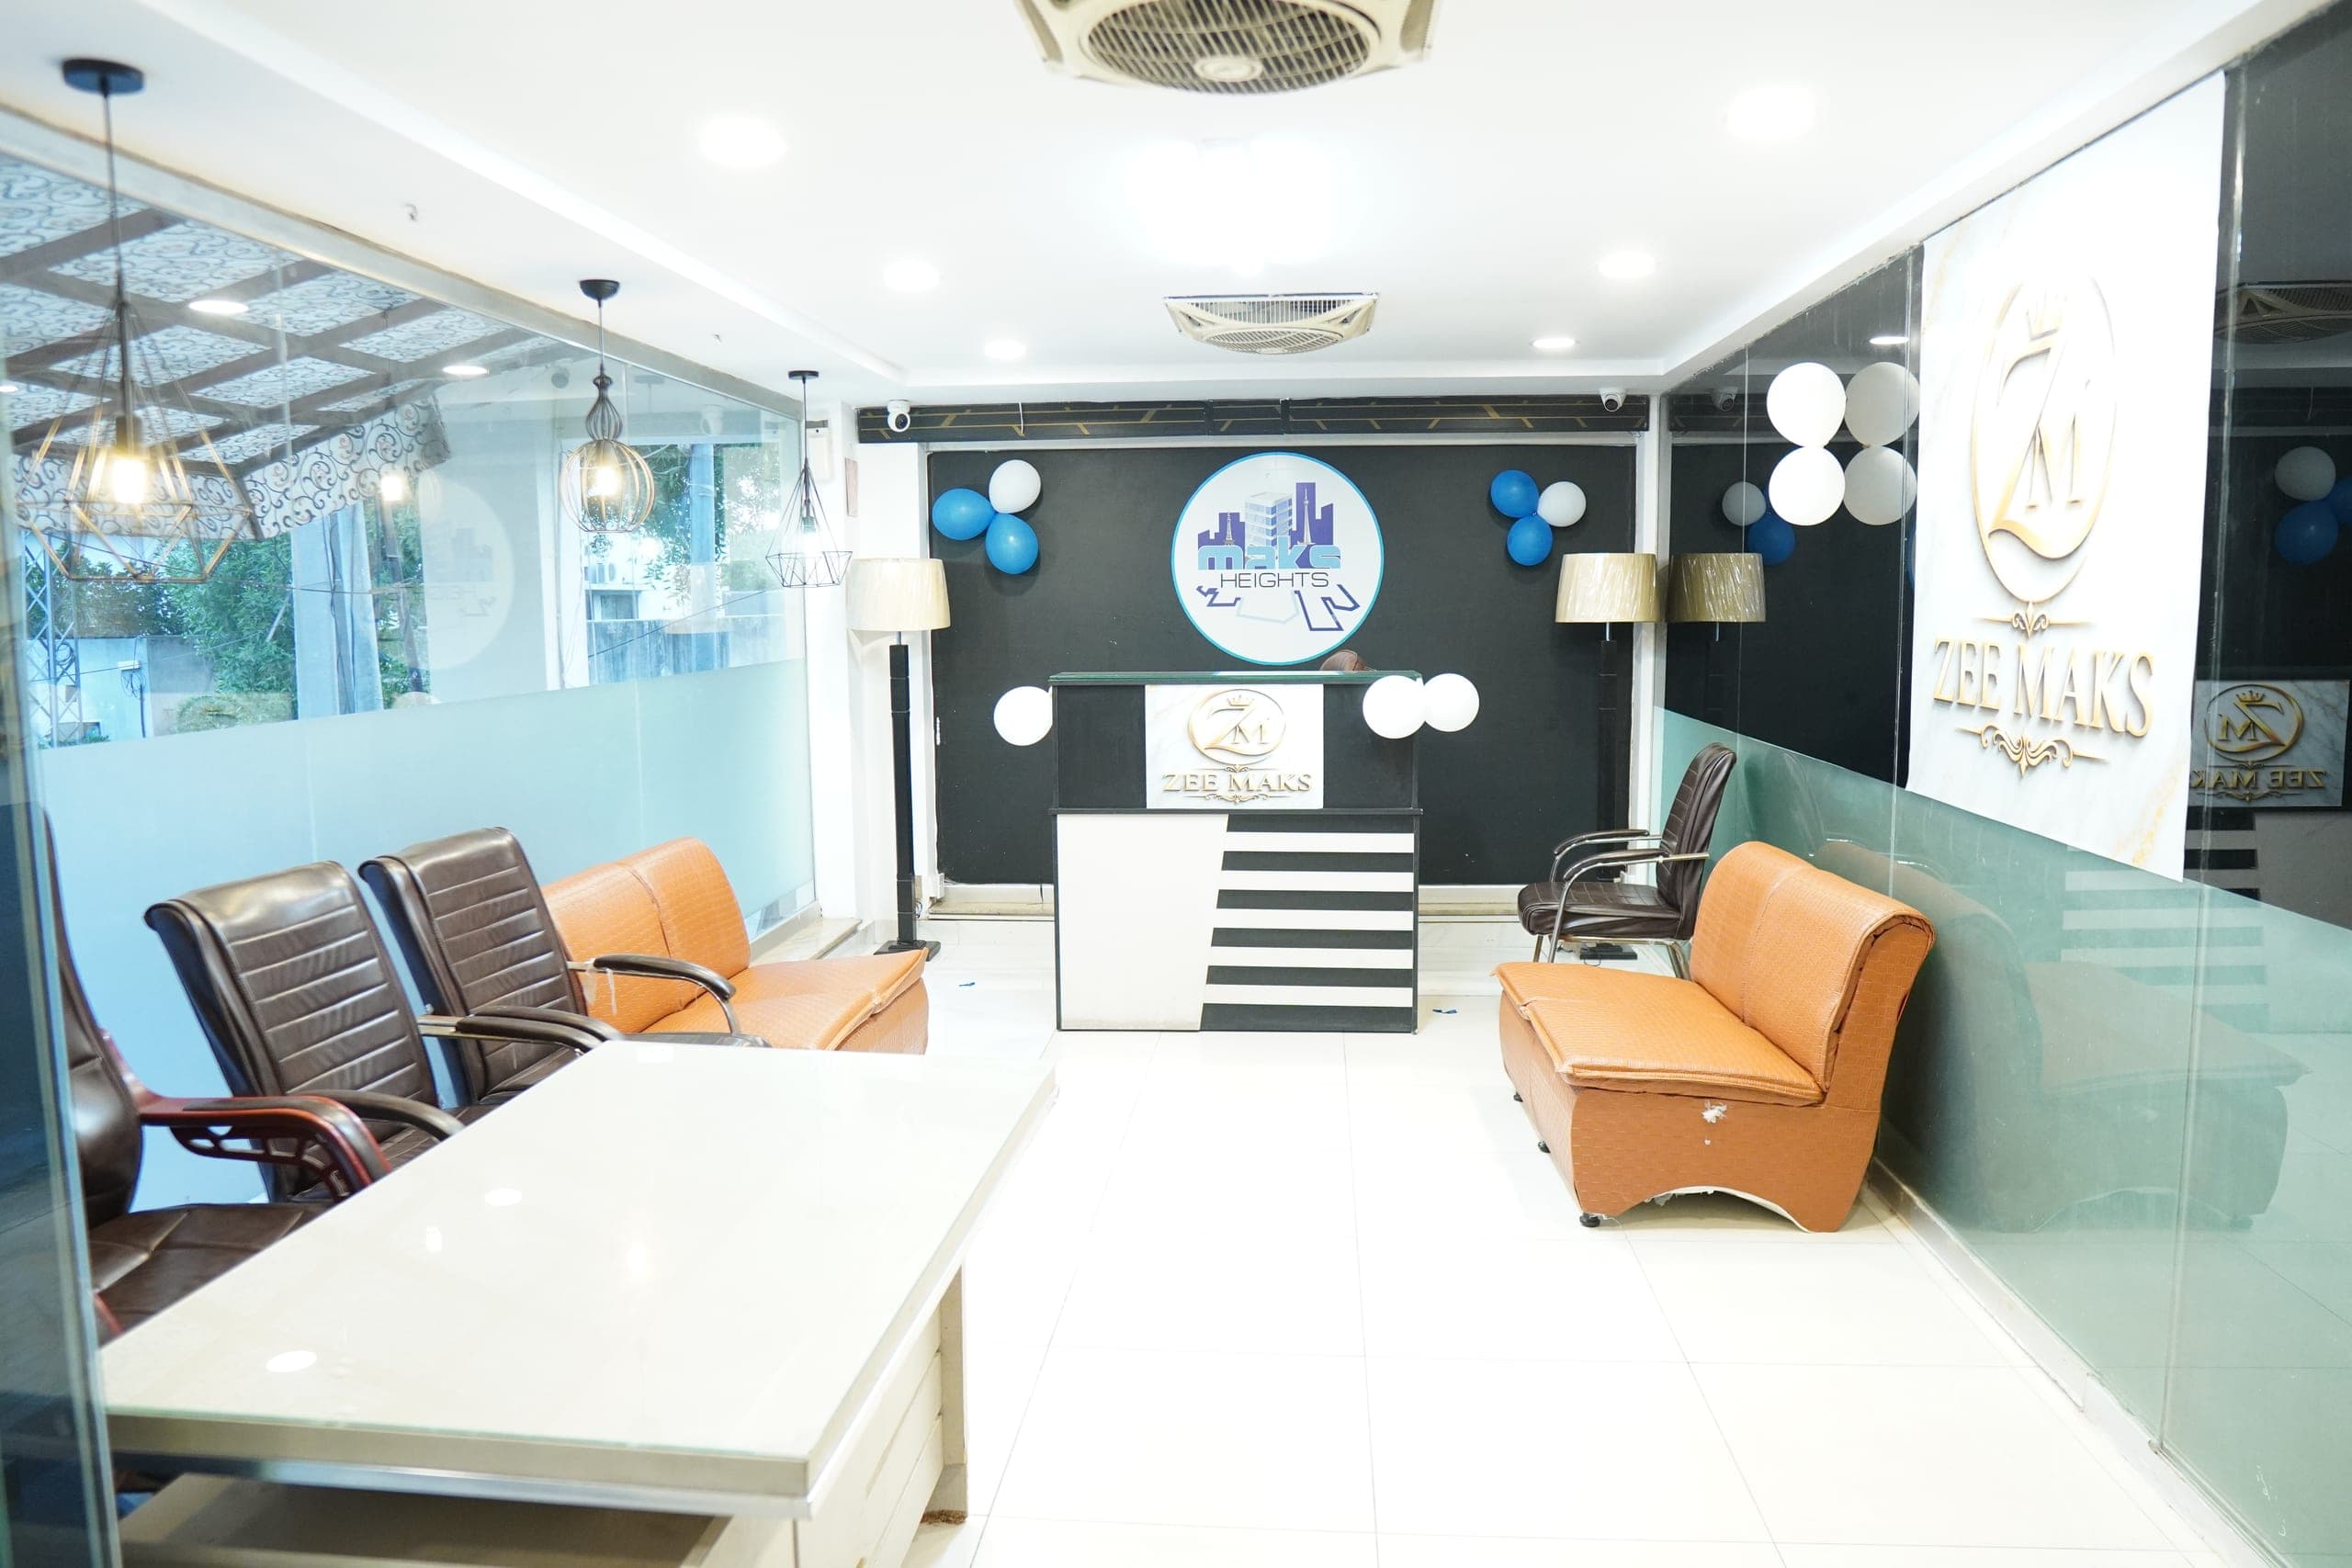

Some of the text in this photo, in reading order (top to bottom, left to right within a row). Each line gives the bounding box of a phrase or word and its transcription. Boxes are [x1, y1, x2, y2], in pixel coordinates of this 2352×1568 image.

[1220, 572, 1329, 588] HEIGHTS
[1933, 637, 2155, 738] ZEE MAKS
[1162, 773, 1313, 792] ZEE MAKS
